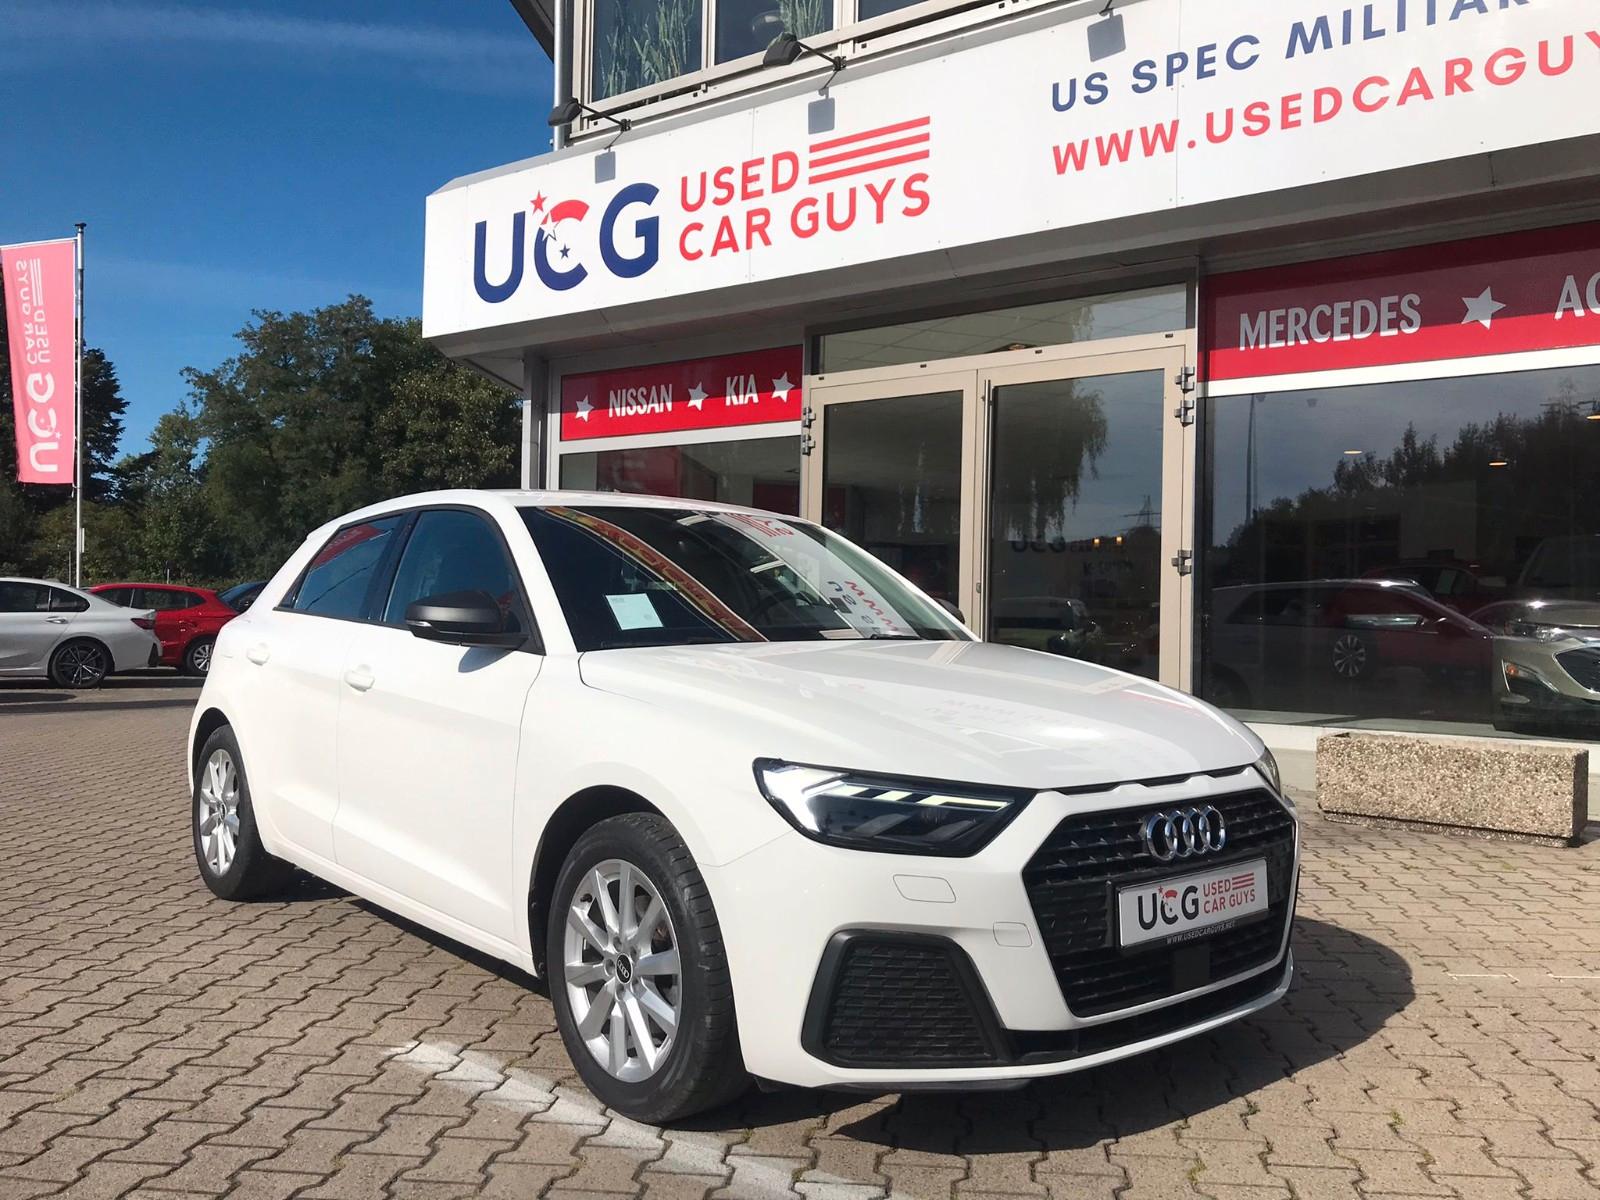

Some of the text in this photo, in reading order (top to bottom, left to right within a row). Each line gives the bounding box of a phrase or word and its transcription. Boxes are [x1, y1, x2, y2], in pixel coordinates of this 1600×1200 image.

[1051, 0, 1529, 112] US SPEC MILITA
[680, 151, 800, 212] USED
[473, 183, 659, 303] UCG
[679, 173, 930, 261] CAR GUYS
[1239, 293, 1421, 351] MERCEDES
[608, 374, 758, 418] NISSAN KIA
[1138, 885, 1199, 930] UCG
[1203, 879, 1231, 897] USED
[1204, 889, 1256, 914] CAR GUYS
